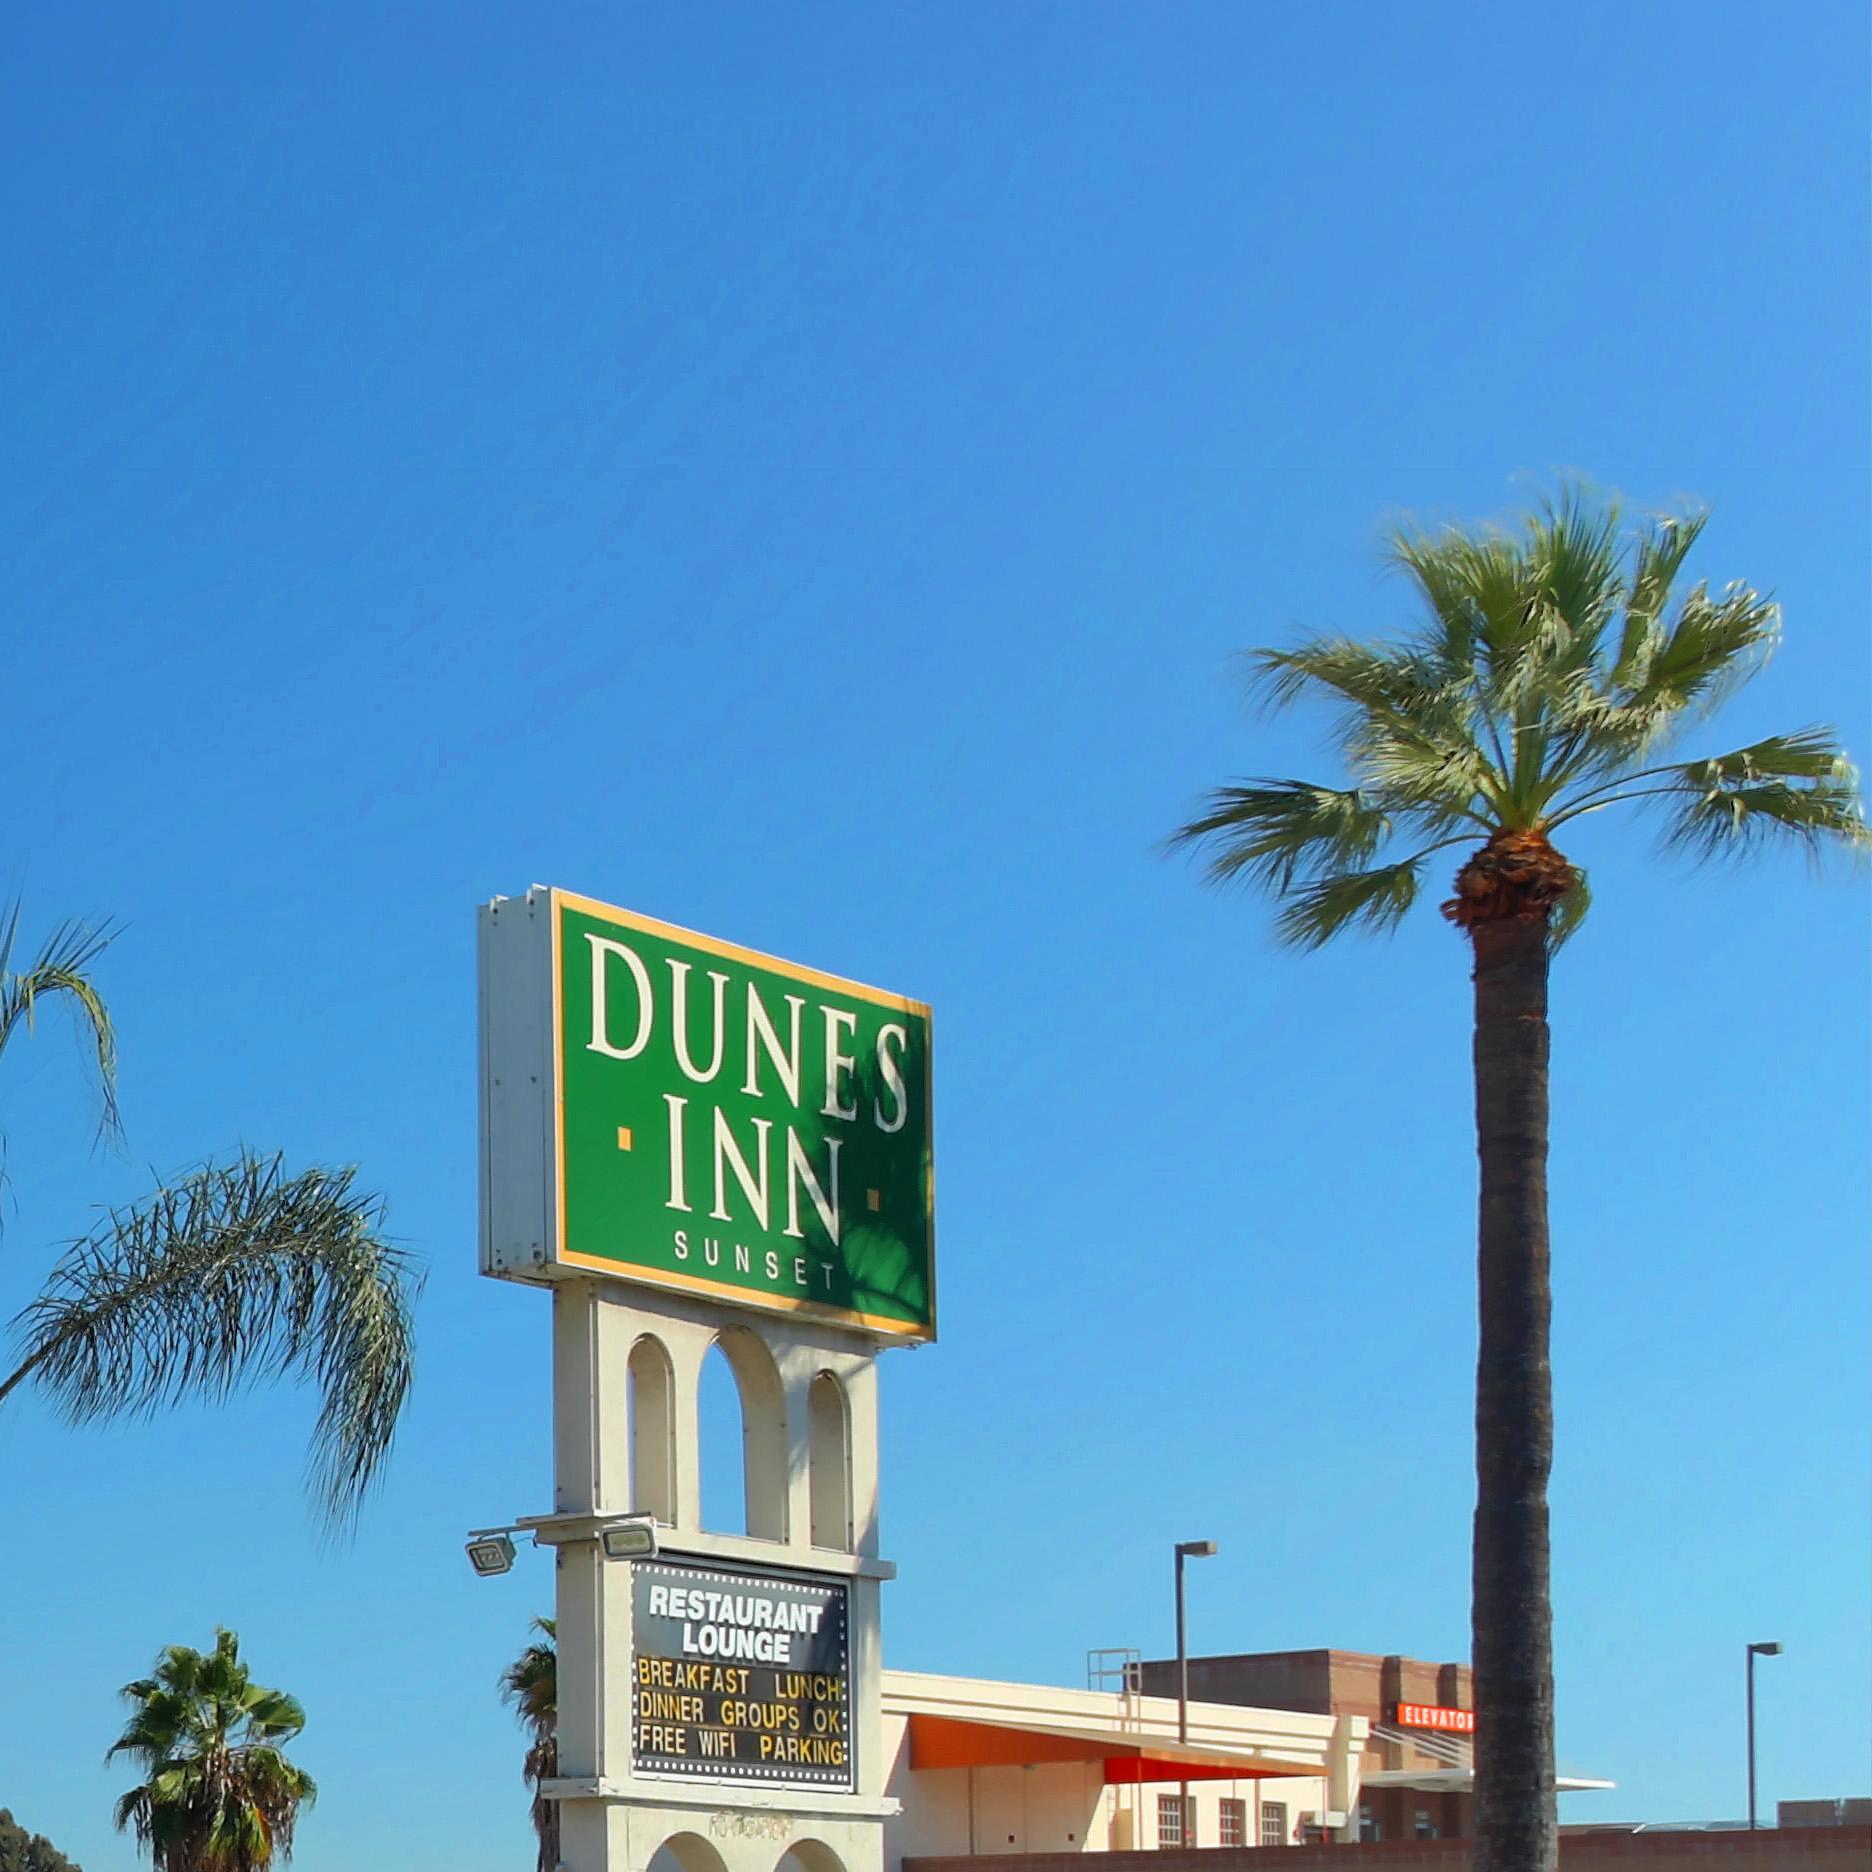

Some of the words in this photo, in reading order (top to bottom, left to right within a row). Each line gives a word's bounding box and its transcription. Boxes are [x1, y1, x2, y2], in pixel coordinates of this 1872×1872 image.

[584, 932, 907, 1133] DUNES
[663, 1093, 844, 1247] INN
[674, 1230, 834, 1290] SUNSET
[649, 1585, 823, 1634] RESTAURANT
[683, 1622, 790, 1663] LOUNGE
[638, 1658, 749, 1695] BREAKFAST
[775, 1673, 841, 1702] LUNCH
[640, 1690, 704, 1723] DINNER
[721, 1700, 800, 1730] GROUPS
[813, 1709, 840, 1734] OK
[639, 1724, 687, 1754] FREE
[698, 1730, 736, 1758] WIFI
[760, 1735, 844, 1765] PARKING
